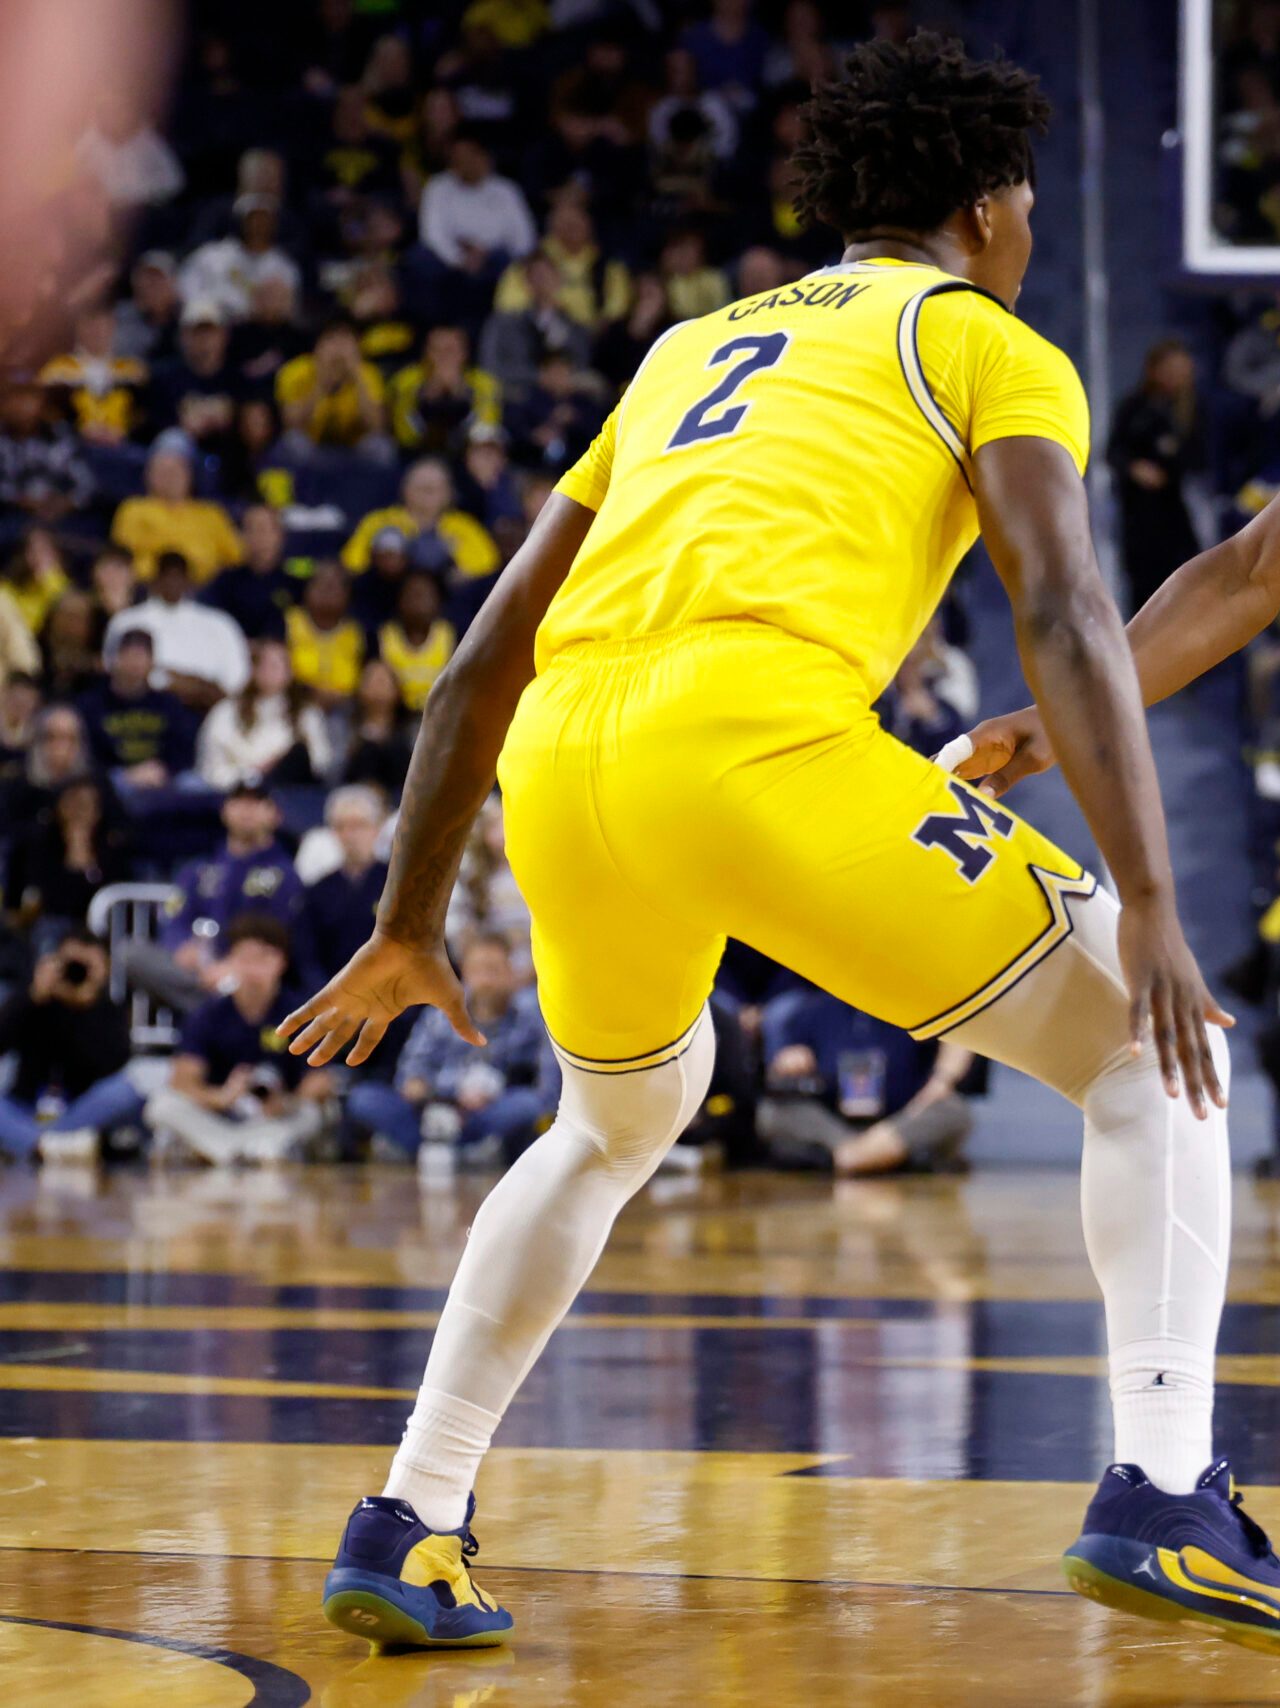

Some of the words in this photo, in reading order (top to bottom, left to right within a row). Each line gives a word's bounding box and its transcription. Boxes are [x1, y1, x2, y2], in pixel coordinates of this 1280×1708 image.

[728, 282, 871, 321] CASON
[663, 330, 792, 451] 2
[911, 779, 1014, 885] M
